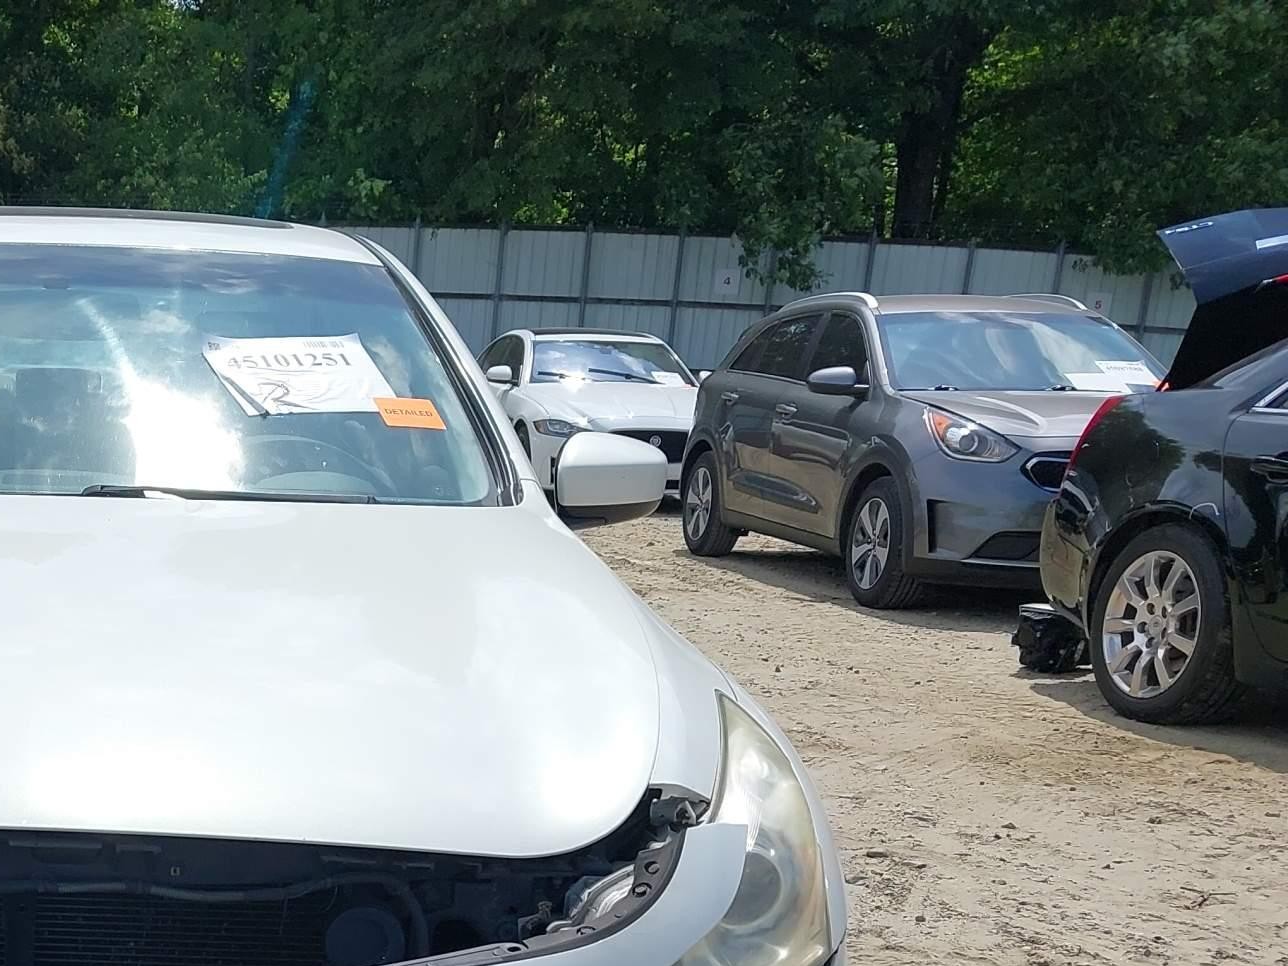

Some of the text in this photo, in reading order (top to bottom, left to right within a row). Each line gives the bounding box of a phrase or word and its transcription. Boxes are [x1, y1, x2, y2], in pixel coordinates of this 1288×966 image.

[723, 276, 731, 285] 4
[227, 353, 352, 369] 45101251
[383, 407, 434, 418] DETAILED
